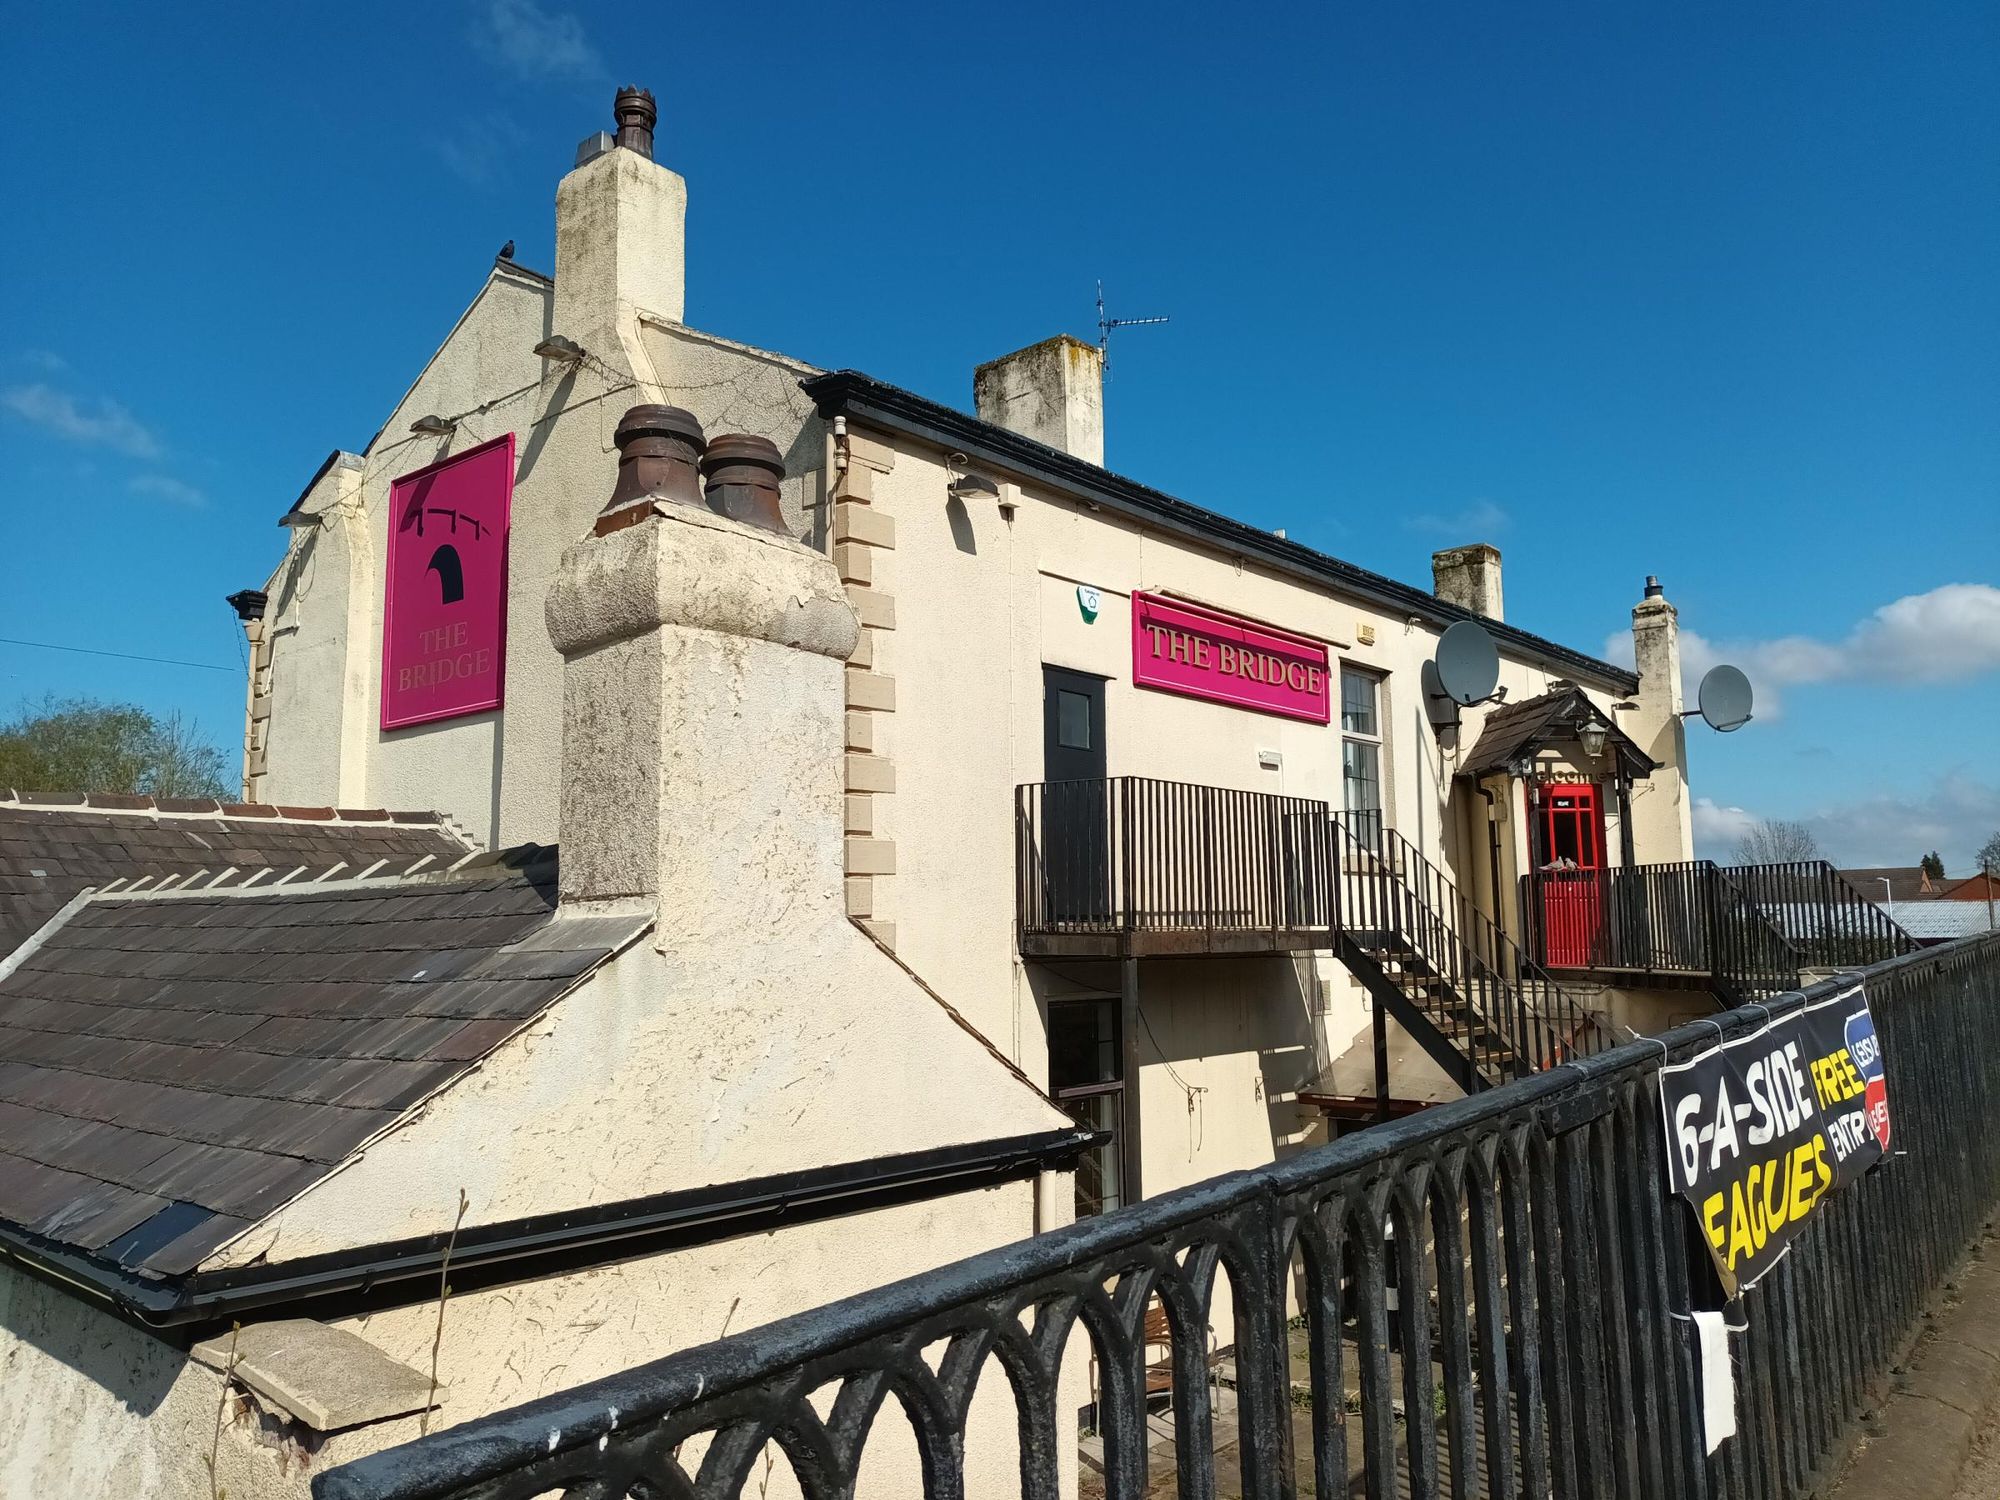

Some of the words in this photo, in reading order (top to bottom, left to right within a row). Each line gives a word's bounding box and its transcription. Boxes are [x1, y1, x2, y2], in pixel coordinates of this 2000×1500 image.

[399, 648, 490, 692] BRIDGE
[419, 622, 468, 654] THE
[1147, 623, 1212, 669] THE
[1217, 643, 1323, 695] BRIDGE
[1810, 1048, 1865, 1111] FREE
[1675, 1041, 1813, 1187] 6-A-SIDE
[1703, 1133, 1832, 1272] EAGUES
